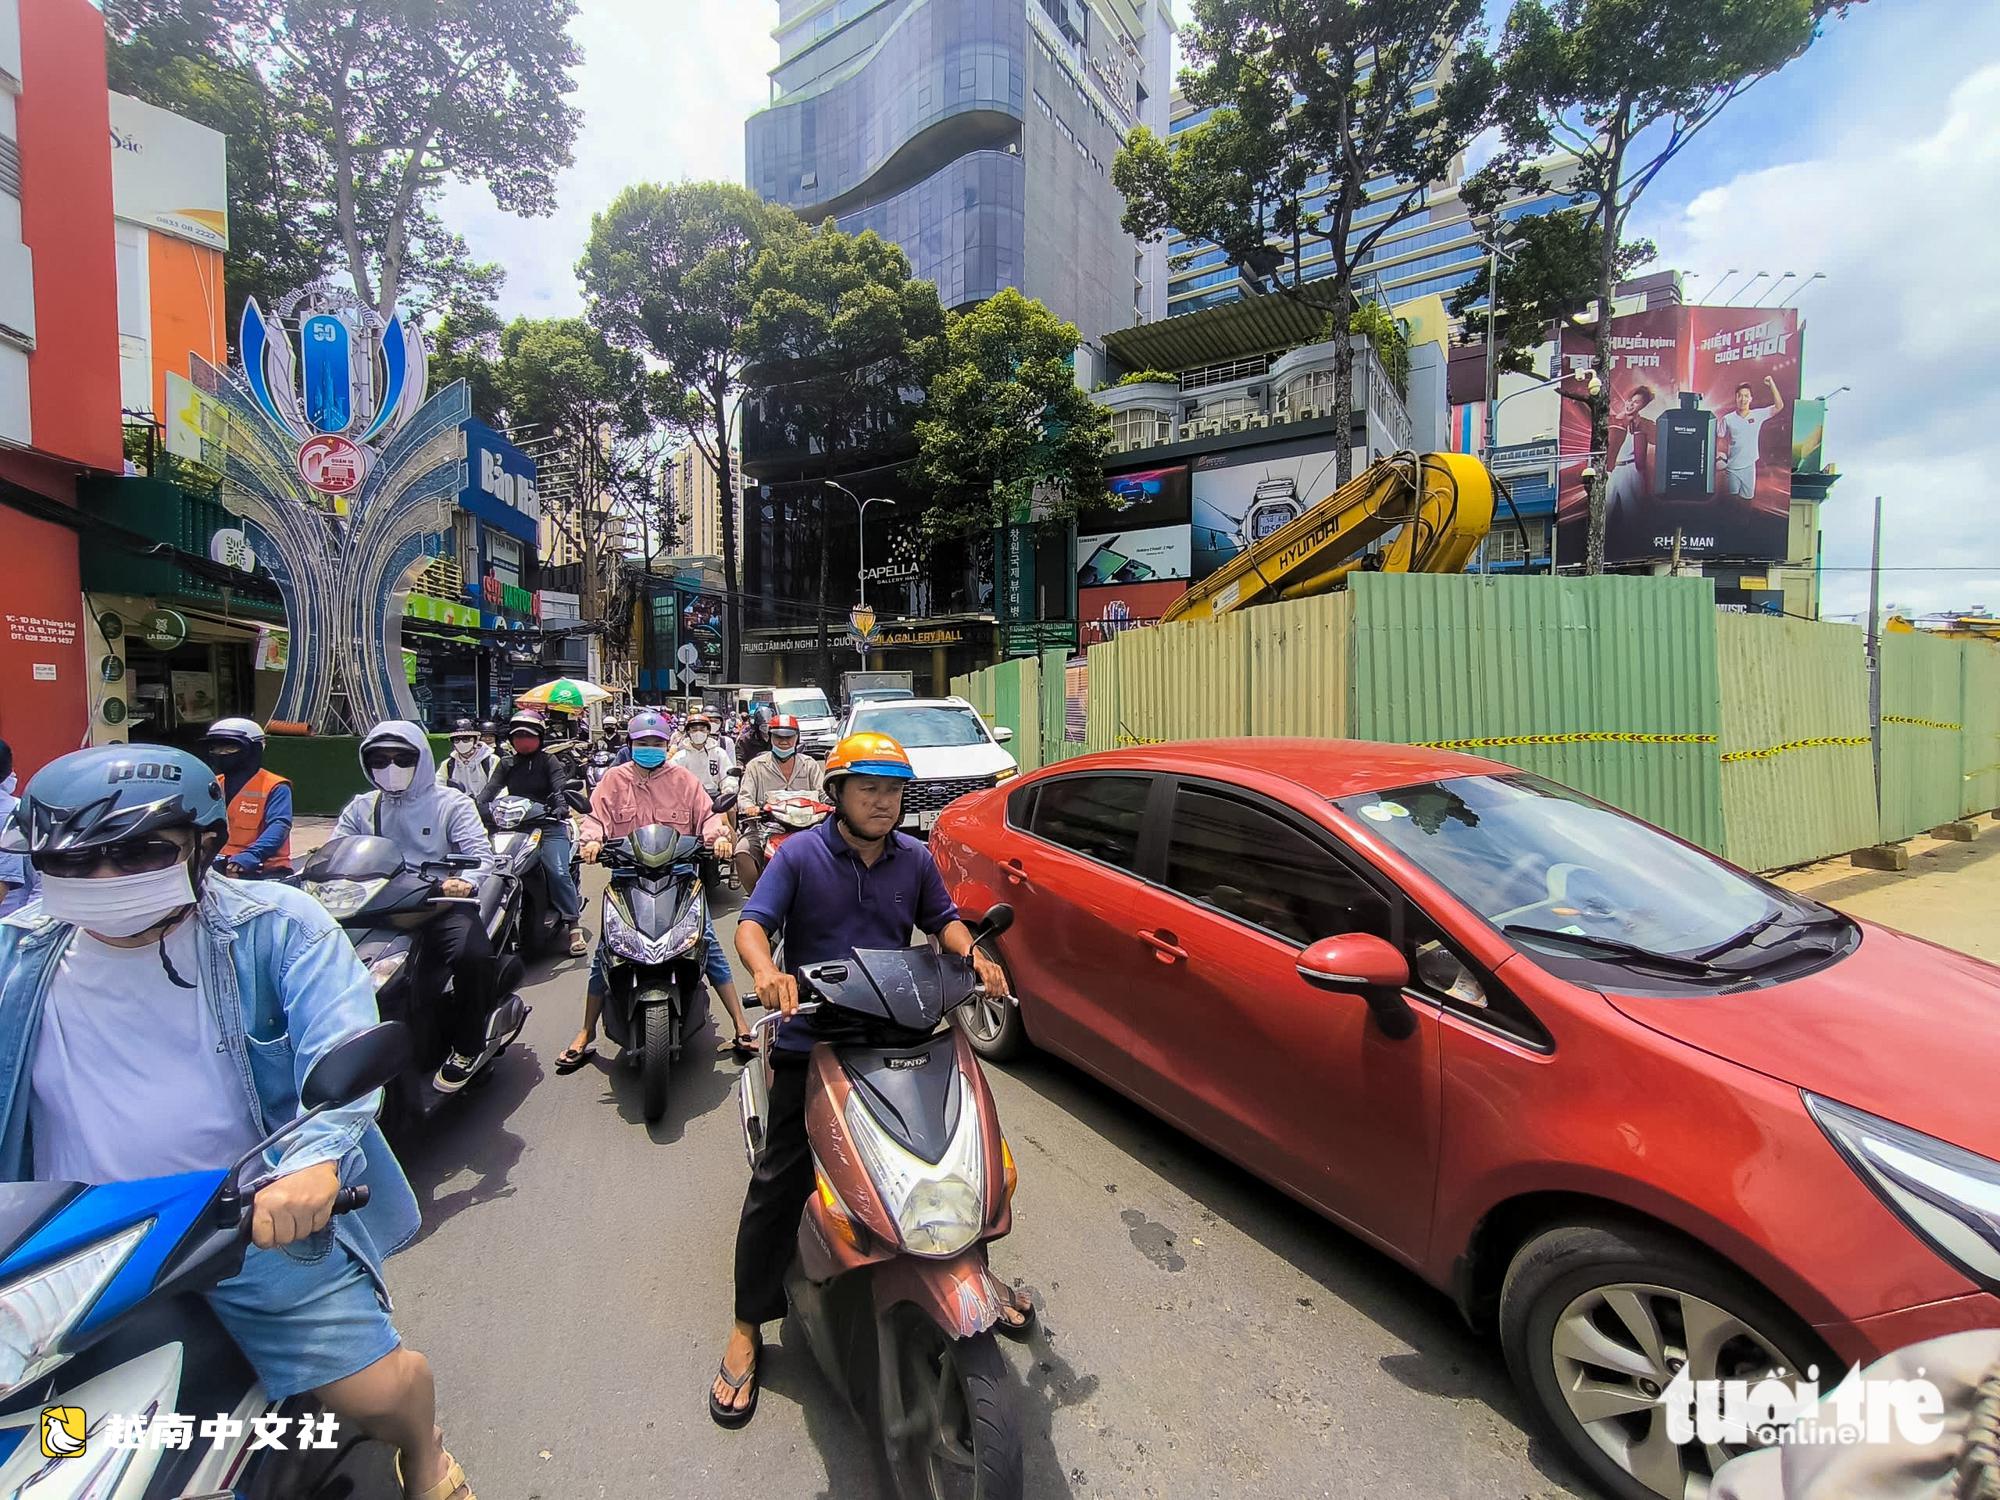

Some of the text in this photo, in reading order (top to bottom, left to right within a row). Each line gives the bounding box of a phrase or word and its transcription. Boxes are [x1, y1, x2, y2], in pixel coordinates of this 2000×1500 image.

[313, 322, 336, 342] 50
[481, 447, 514, 507] Bảo
[1279, 515, 1340, 570] HYUNDAI
[1653, 536, 1714, 547] RHS MAN
[858, 562, 919, 580] CAPELLA
[877, 577, 903, 585] GALLERY
[895, 631, 935, 644] GALLERY
[239, 807, 258, 815] Food
